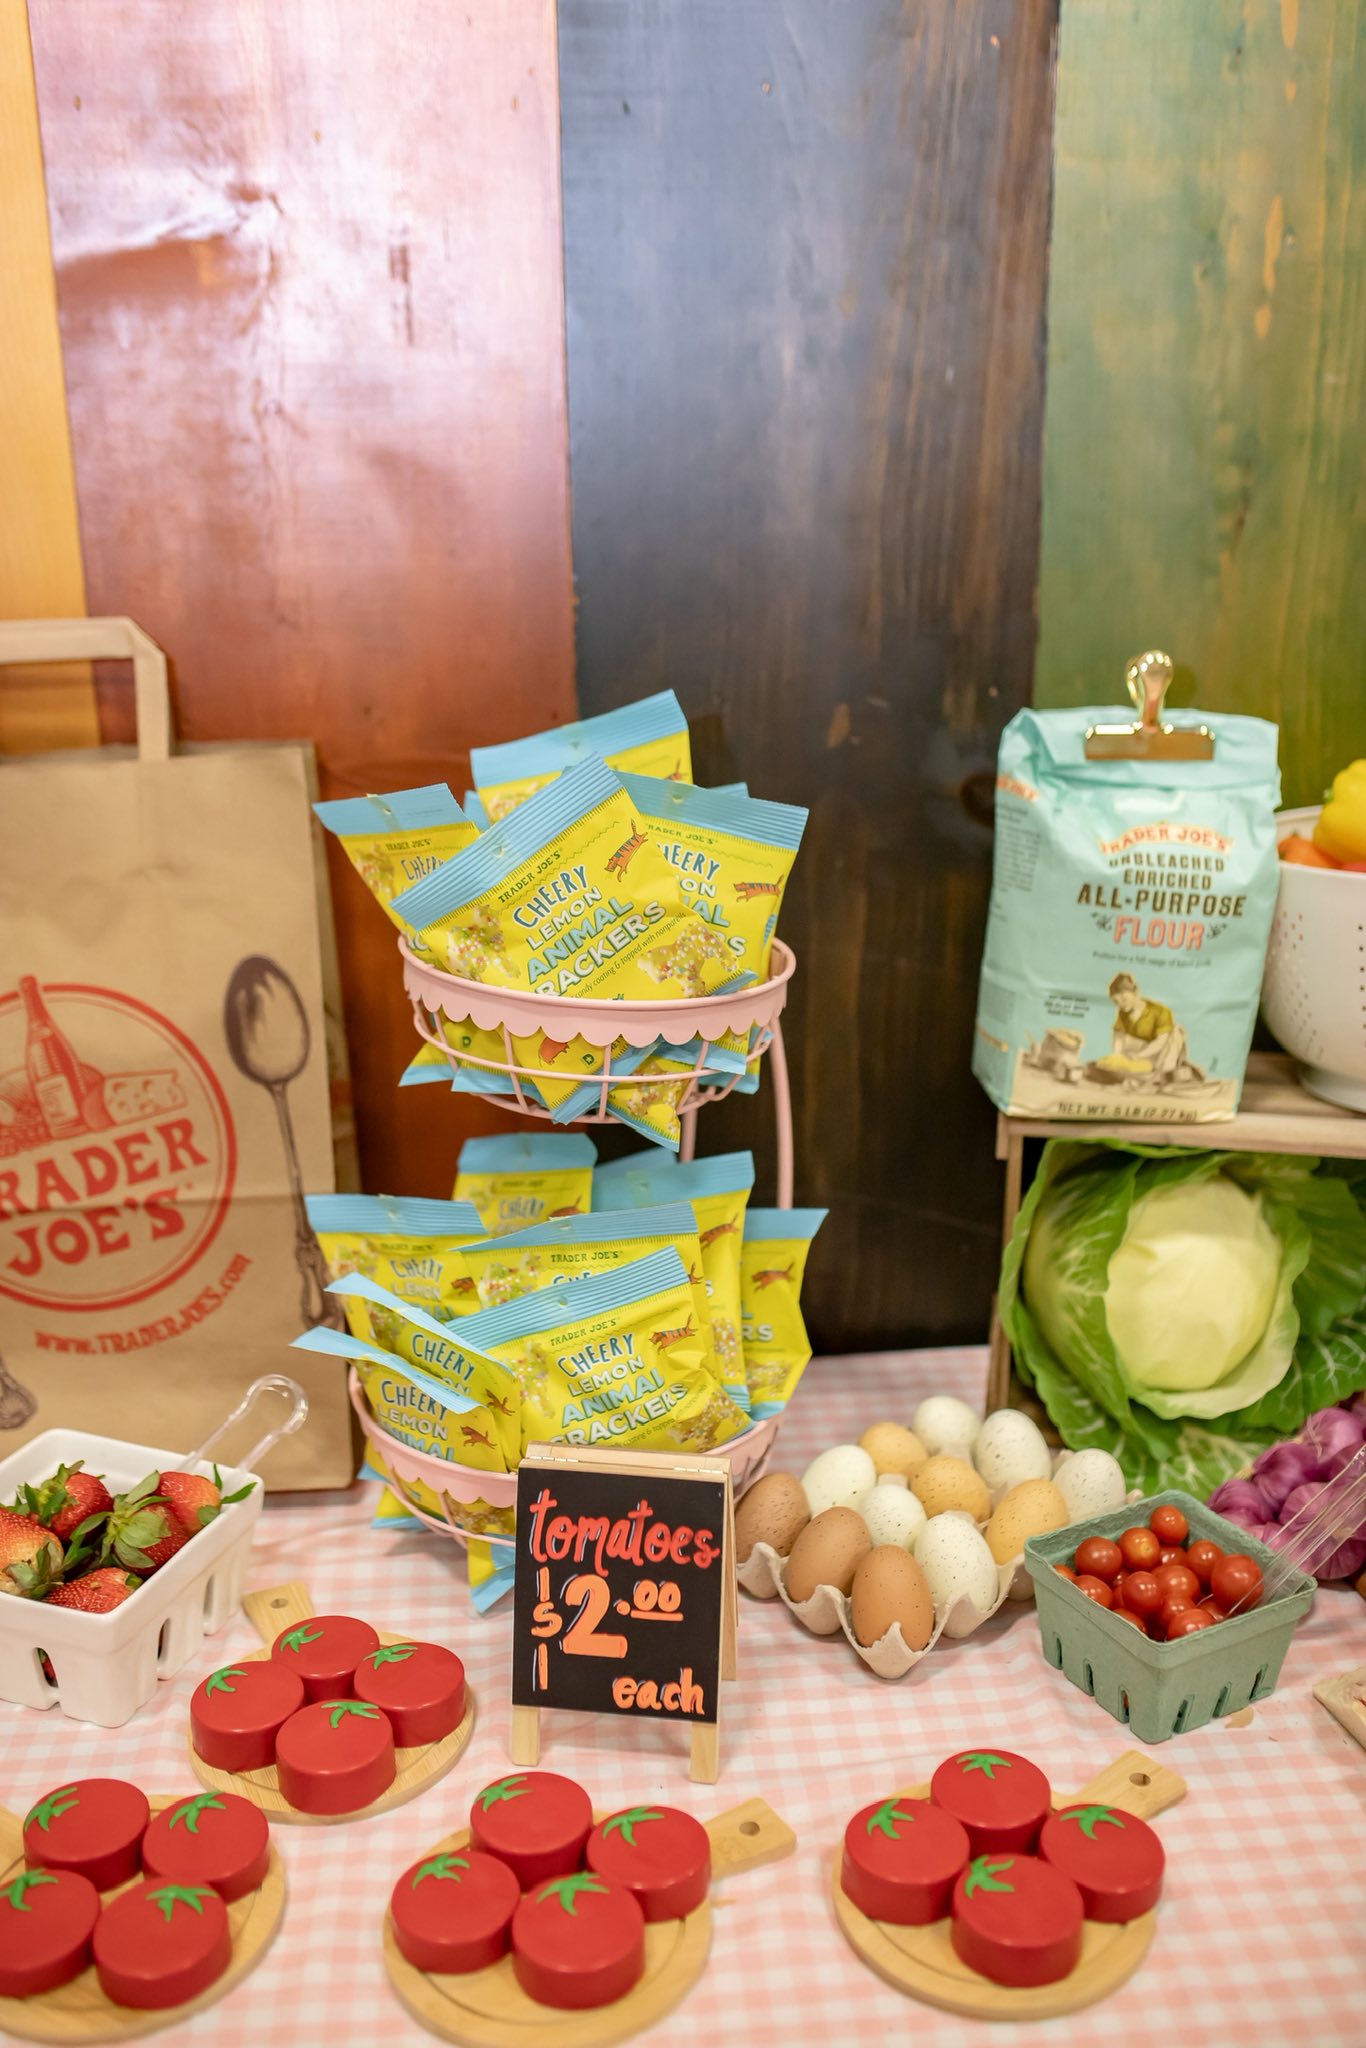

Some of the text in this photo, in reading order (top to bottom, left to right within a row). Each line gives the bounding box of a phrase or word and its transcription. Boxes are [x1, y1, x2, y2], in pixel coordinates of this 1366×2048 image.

[646, 824, 714, 845] RADER JOE'S
[498, 850, 561, 903] TRADER JOE'S
[1109, 852, 1225, 872] UNBLEACHED
[1123, 868, 1212, 890] ENRICHED
[512, 865, 589, 928] CHEERY
[526, 887, 602, 950] LEMON
[1077, 883, 1247, 918] ALL-PURPOSE
[527, 897, 634, 984] ANIMAL
[534, 901, 667, 997] RACKERS
[592, 964, 617, 986] coating
[620, 944, 643, 965] topped
[642, 934, 656, 948] with
[655, 911, 687, 939] nonpareils
[1113, 915, 1206, 951] FLOUR
[0, 1118, 209, 1223] RADER
[7, 1187, 187, 1277] JOE'S
[551, 1250, 619, 1263] TRADER JOE'S
[412, 1334, 475, 1381] CHEERY
[550, 1318, 617, 1347] TRADER JOE'S
[557, 1333, 634, 1378] CHEERY
[381, 1380, 448, 1421] CHEERY
[561, 1368, 665, 1428] ANIMAL
[567, 1355, 645, 1397] LEMON
[377, 1402, 449, 1441] LEMON
[551, 1384, 689, 1445] RACKERS
[529, 1488, 720, 1577] tomatoes
[530, 1566, 684, 1691] $2.00
[612, 1666, 706, 1716] each
